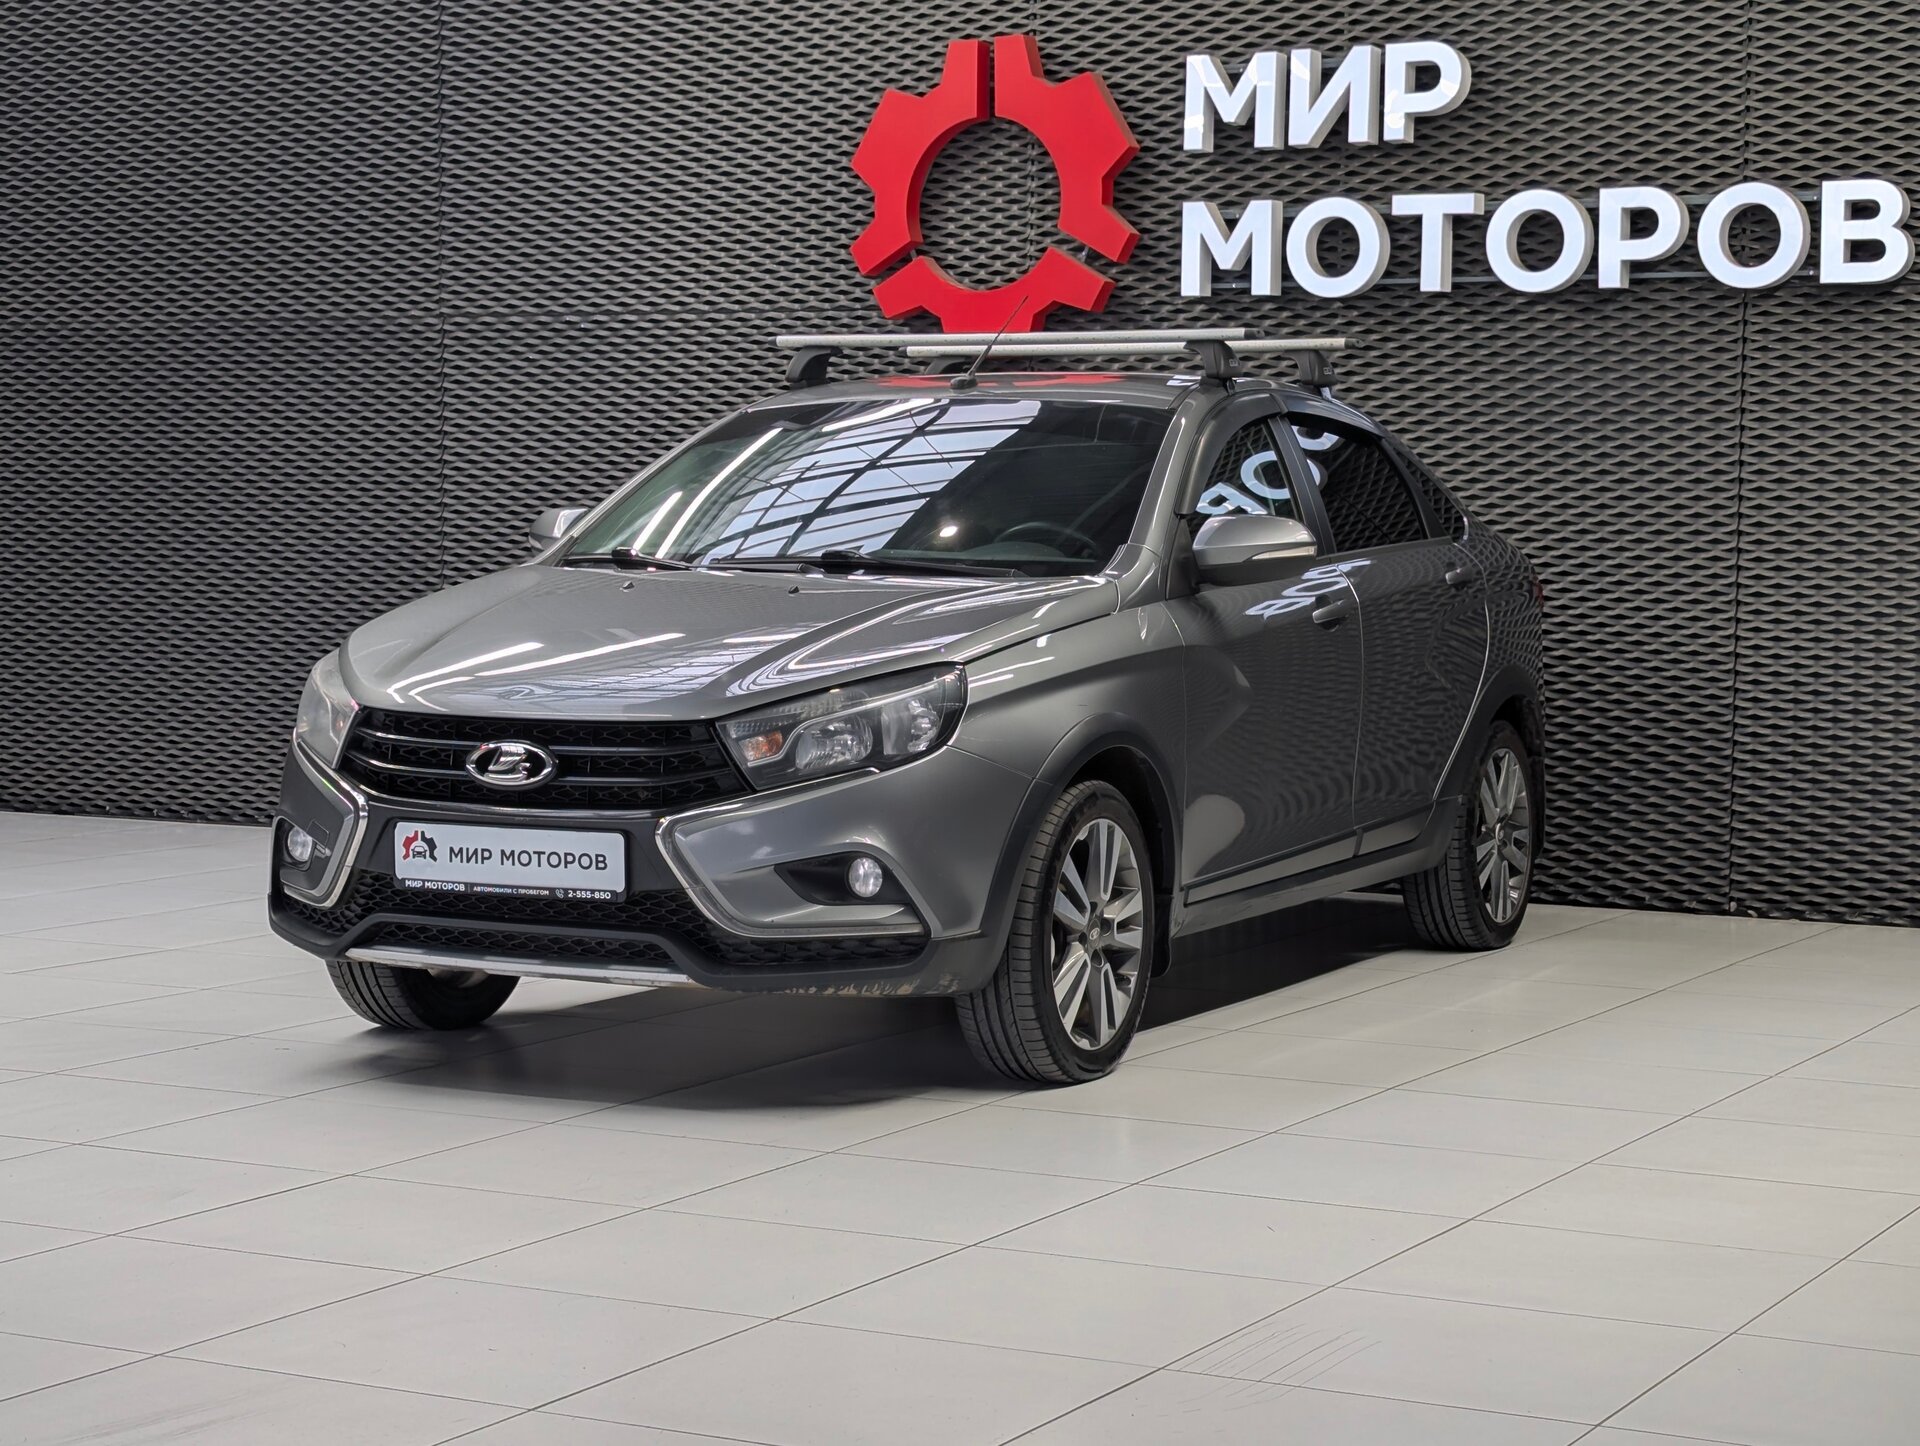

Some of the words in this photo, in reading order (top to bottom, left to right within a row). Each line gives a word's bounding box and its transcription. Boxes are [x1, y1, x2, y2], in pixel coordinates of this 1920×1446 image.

[1183, 41, 1471, 153] МИР
[1180, 179, 1915, 299] МОТОРОВ
[405, 879, 423, 888] МИР
[424, 880, 466, 892] МОТОРОВ
[473, 885, 512, 894] АВТОМОБИЛИ
[518, 887, 550, 896] ПРОБЕГОМ
[567, 889, 612, 900] 2-555-850
[449, 846, 493, 865] МИР
[500, 849, 608, 871] МОТОРОВ
